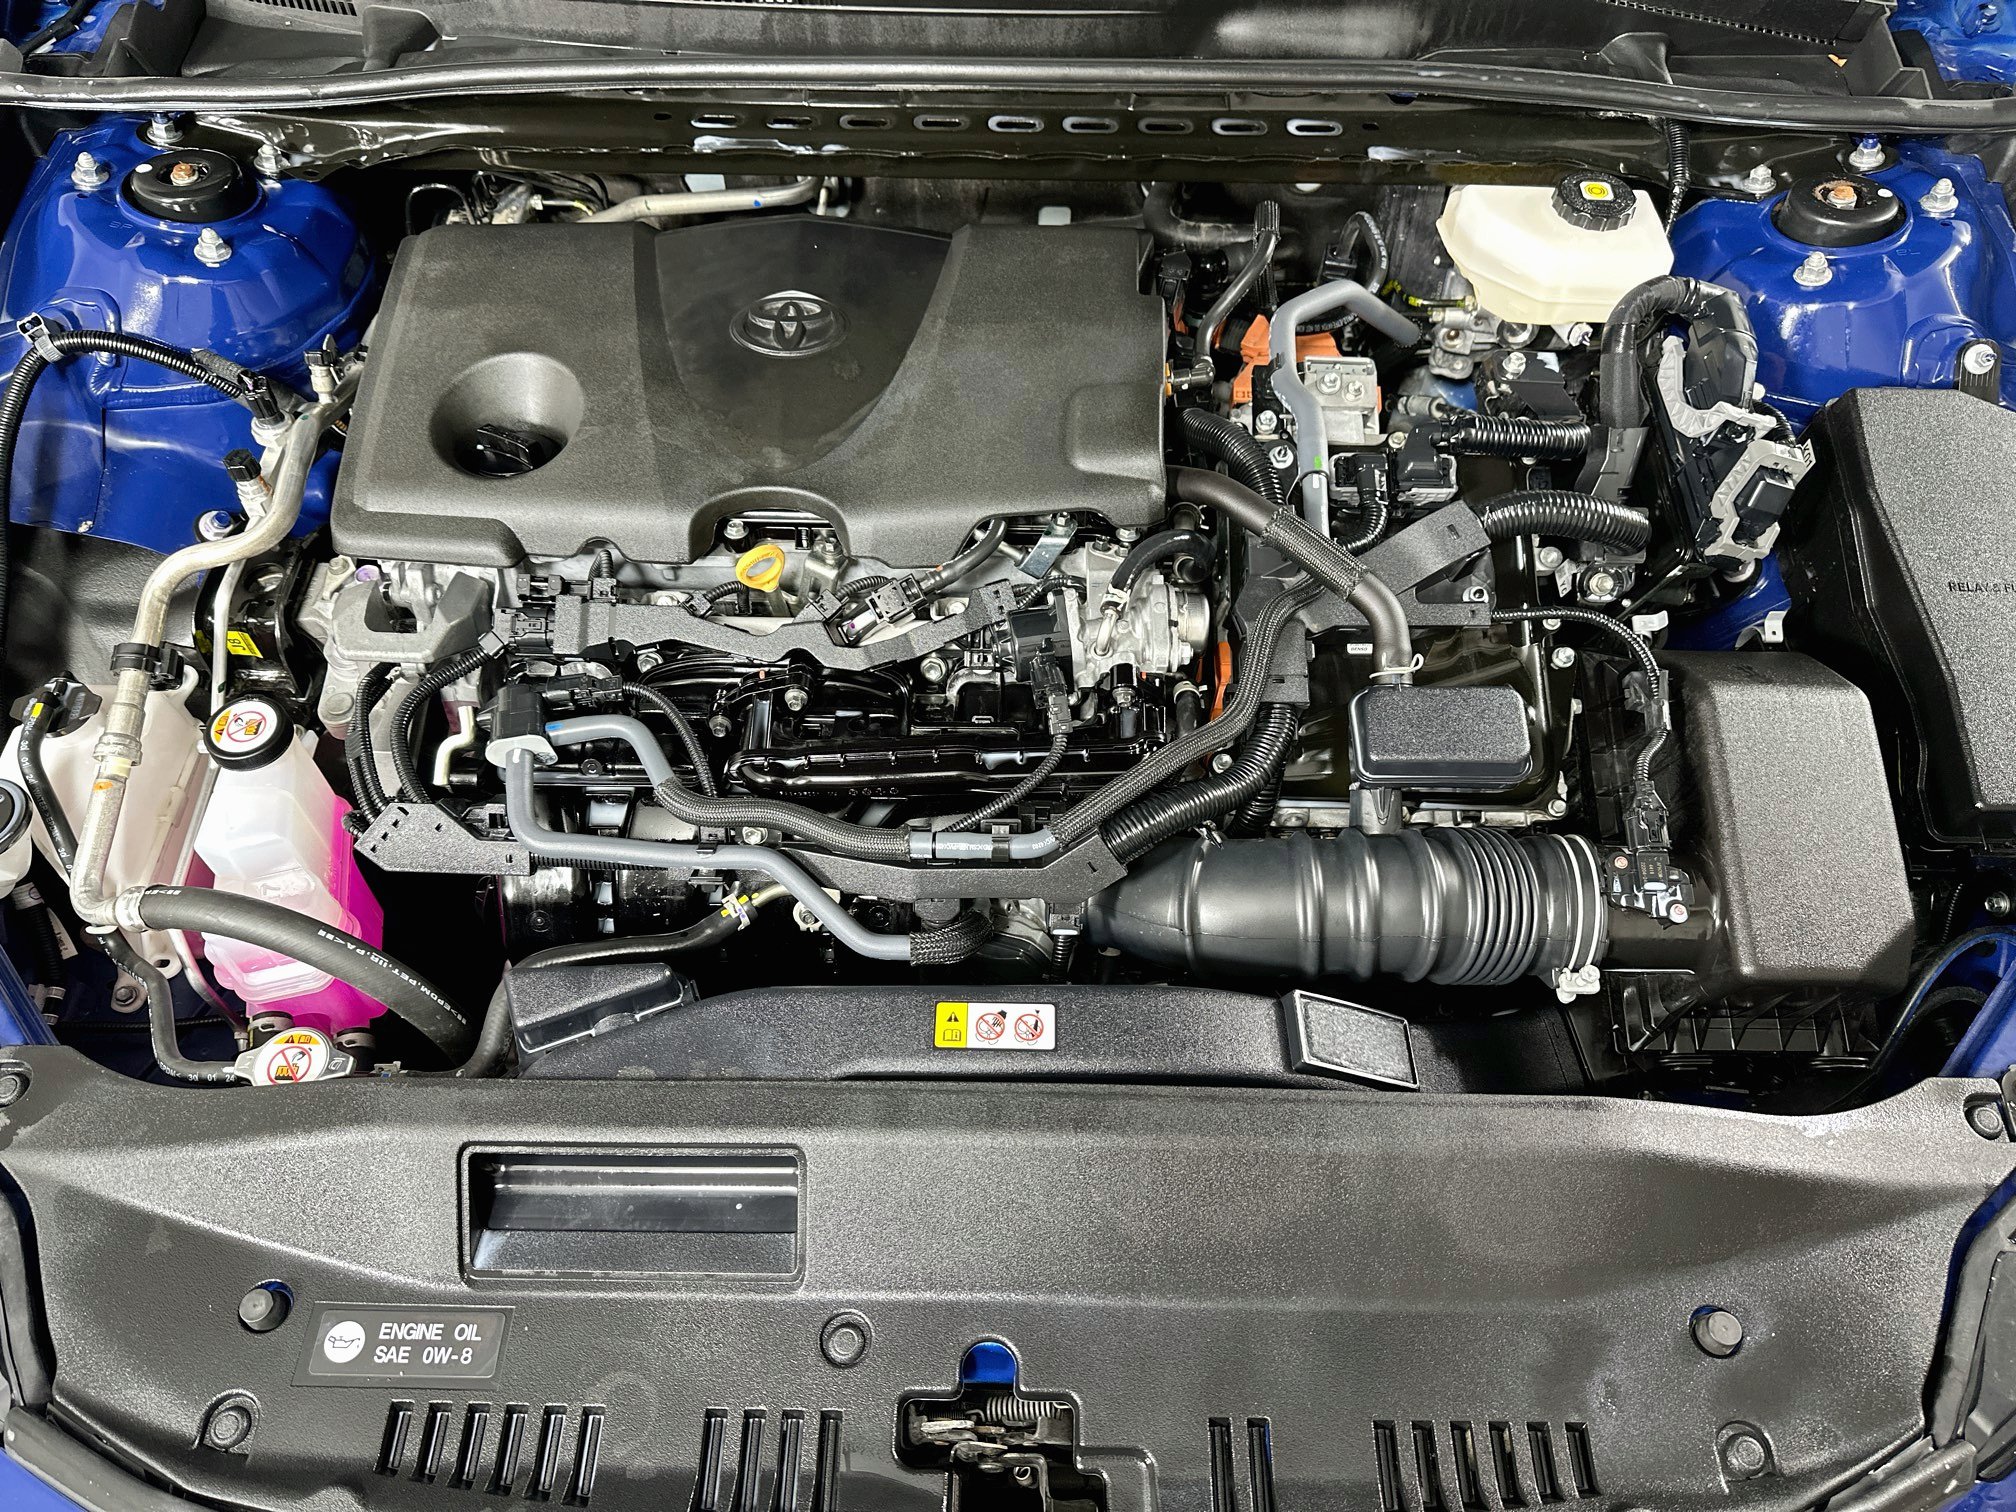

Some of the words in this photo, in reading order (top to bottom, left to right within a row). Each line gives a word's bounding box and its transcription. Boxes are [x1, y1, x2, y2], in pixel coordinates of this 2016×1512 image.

[1948, 581, 1989, 593] RELAY
[378, 1322, 444, 1341] ENGINE
[454, 1323, 482, 1341] OIL
[373, 1345, 411, 1364] SAE
[422, 1346, 473, 1365] 0W-8
